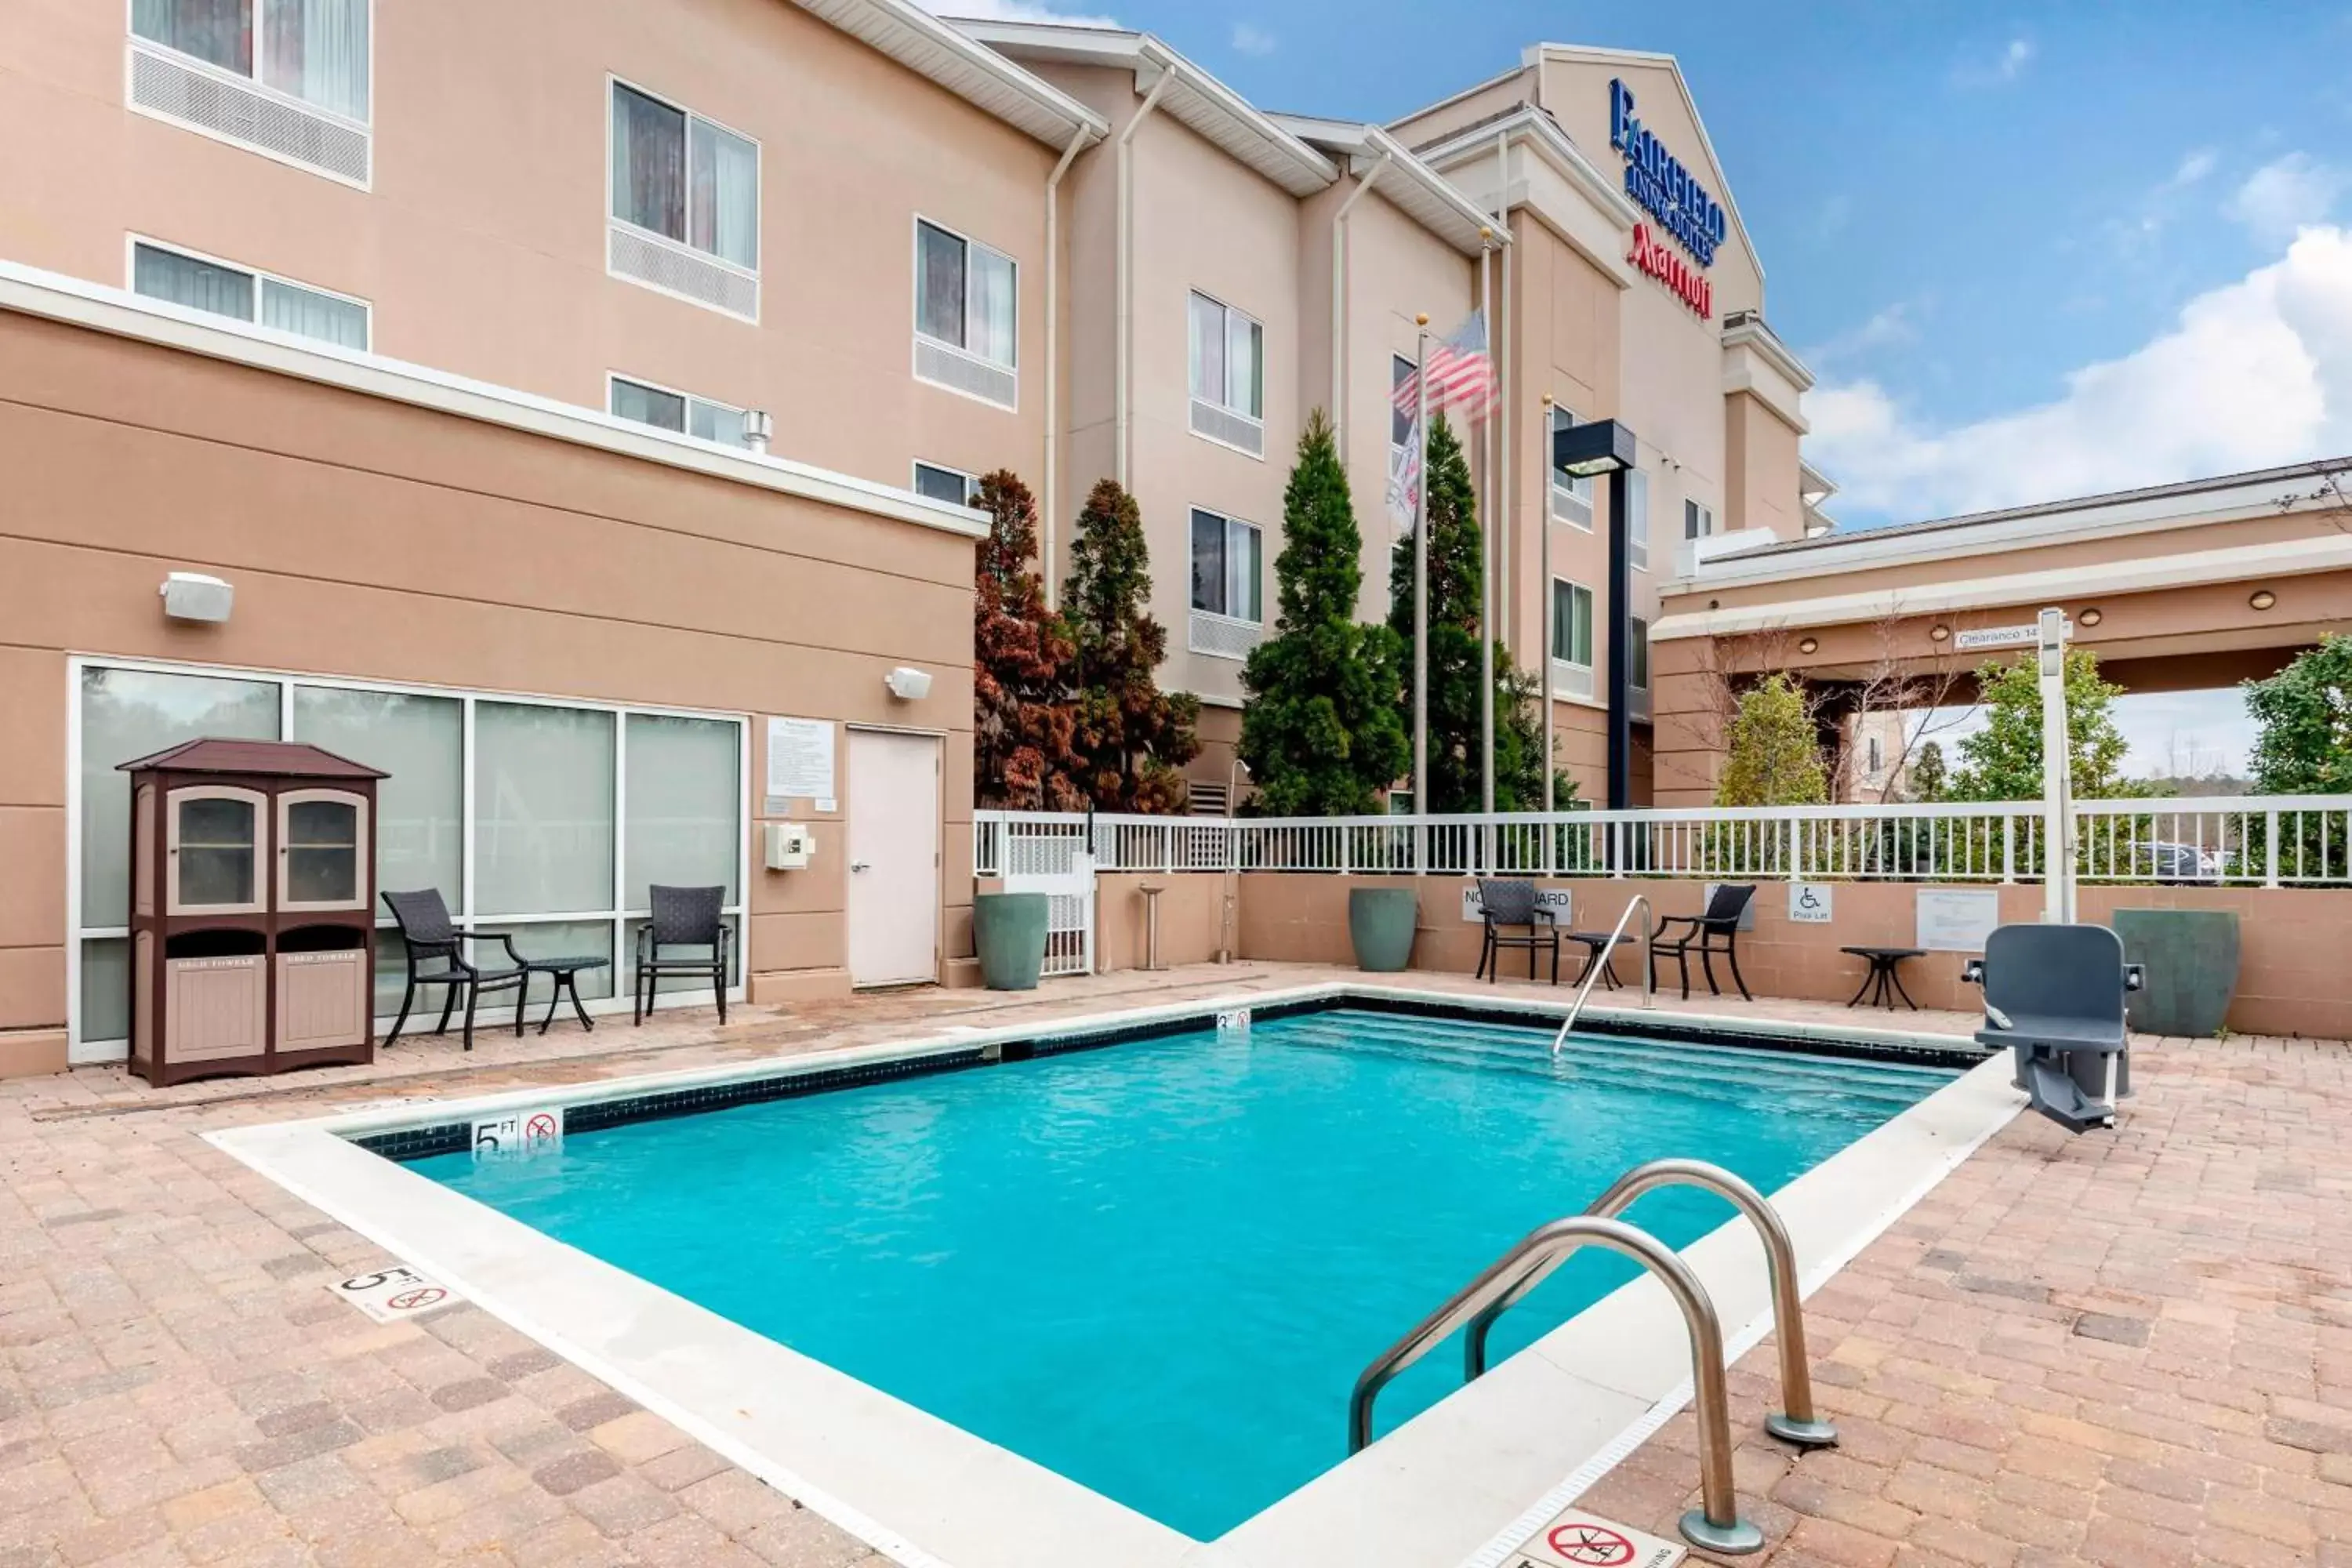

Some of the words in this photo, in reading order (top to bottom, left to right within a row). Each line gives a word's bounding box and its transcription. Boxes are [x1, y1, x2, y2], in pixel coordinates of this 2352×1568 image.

[1610, 78, 1726, 247] FAIRFIELD
[1625, 165, 1662, 220] INN
[1671, 209, 1715, 267] SUITES
[1626, 223, 1713, 319] Marriott
[477, 1123, 499, 1152] 5
[501, 1120, 516, 1134] FT
[341, 1268, 412, 1290] 5
